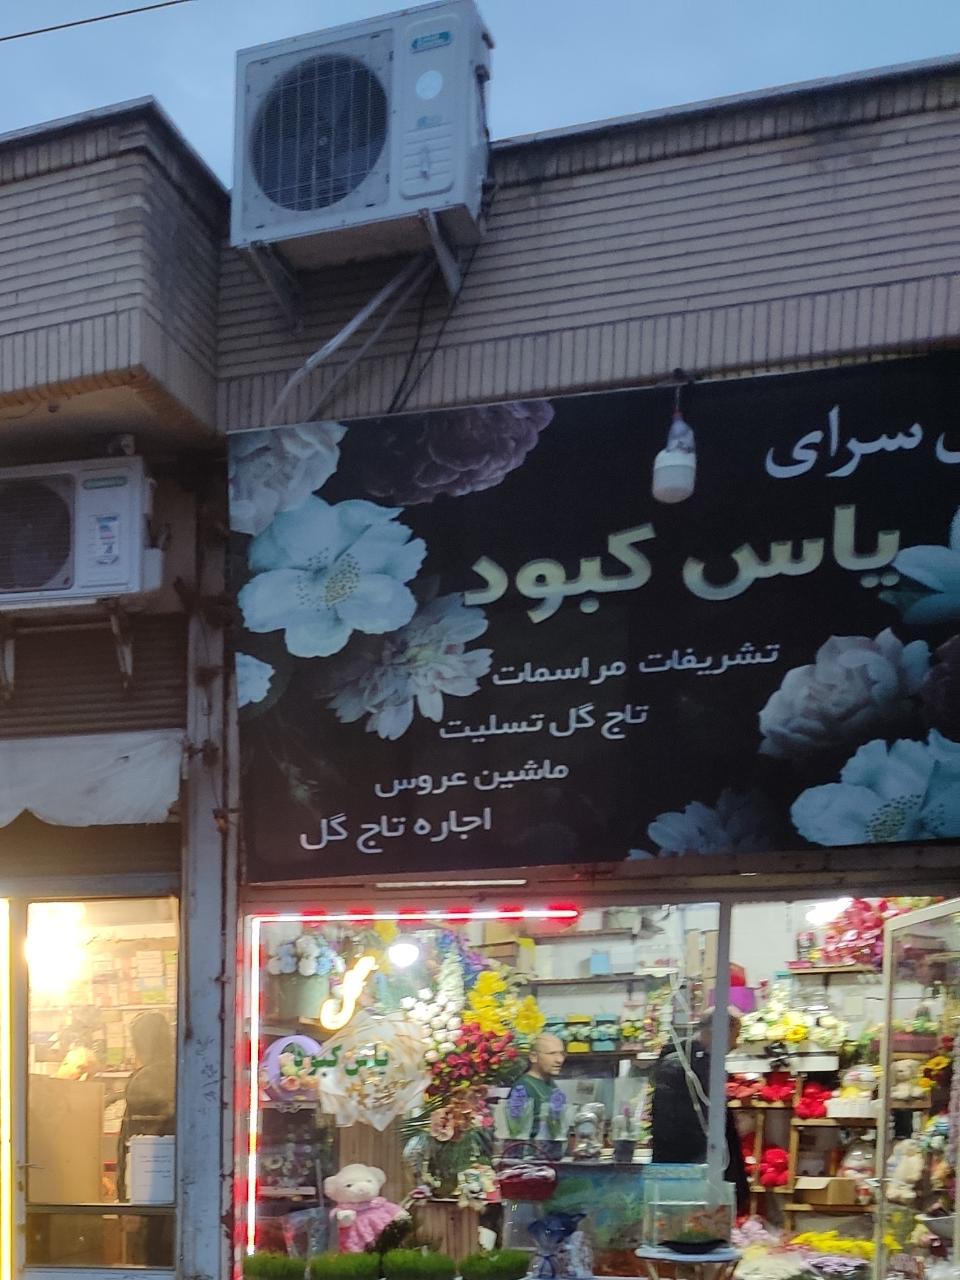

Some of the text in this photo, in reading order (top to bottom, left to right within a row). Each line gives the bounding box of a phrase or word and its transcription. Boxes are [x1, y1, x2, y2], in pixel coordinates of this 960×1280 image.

[765, 404, 924, 479] سرای
[463, 504, 900, 625] یاس کبود
[492, 642, 781, 686] تشریفات مراسمات
[439, 702, 651, 744] تاج گل تسلیت
[373, 759, 570, 798] ماشین عروس
[299, 807, 492, 854] اجاره تاج گل
